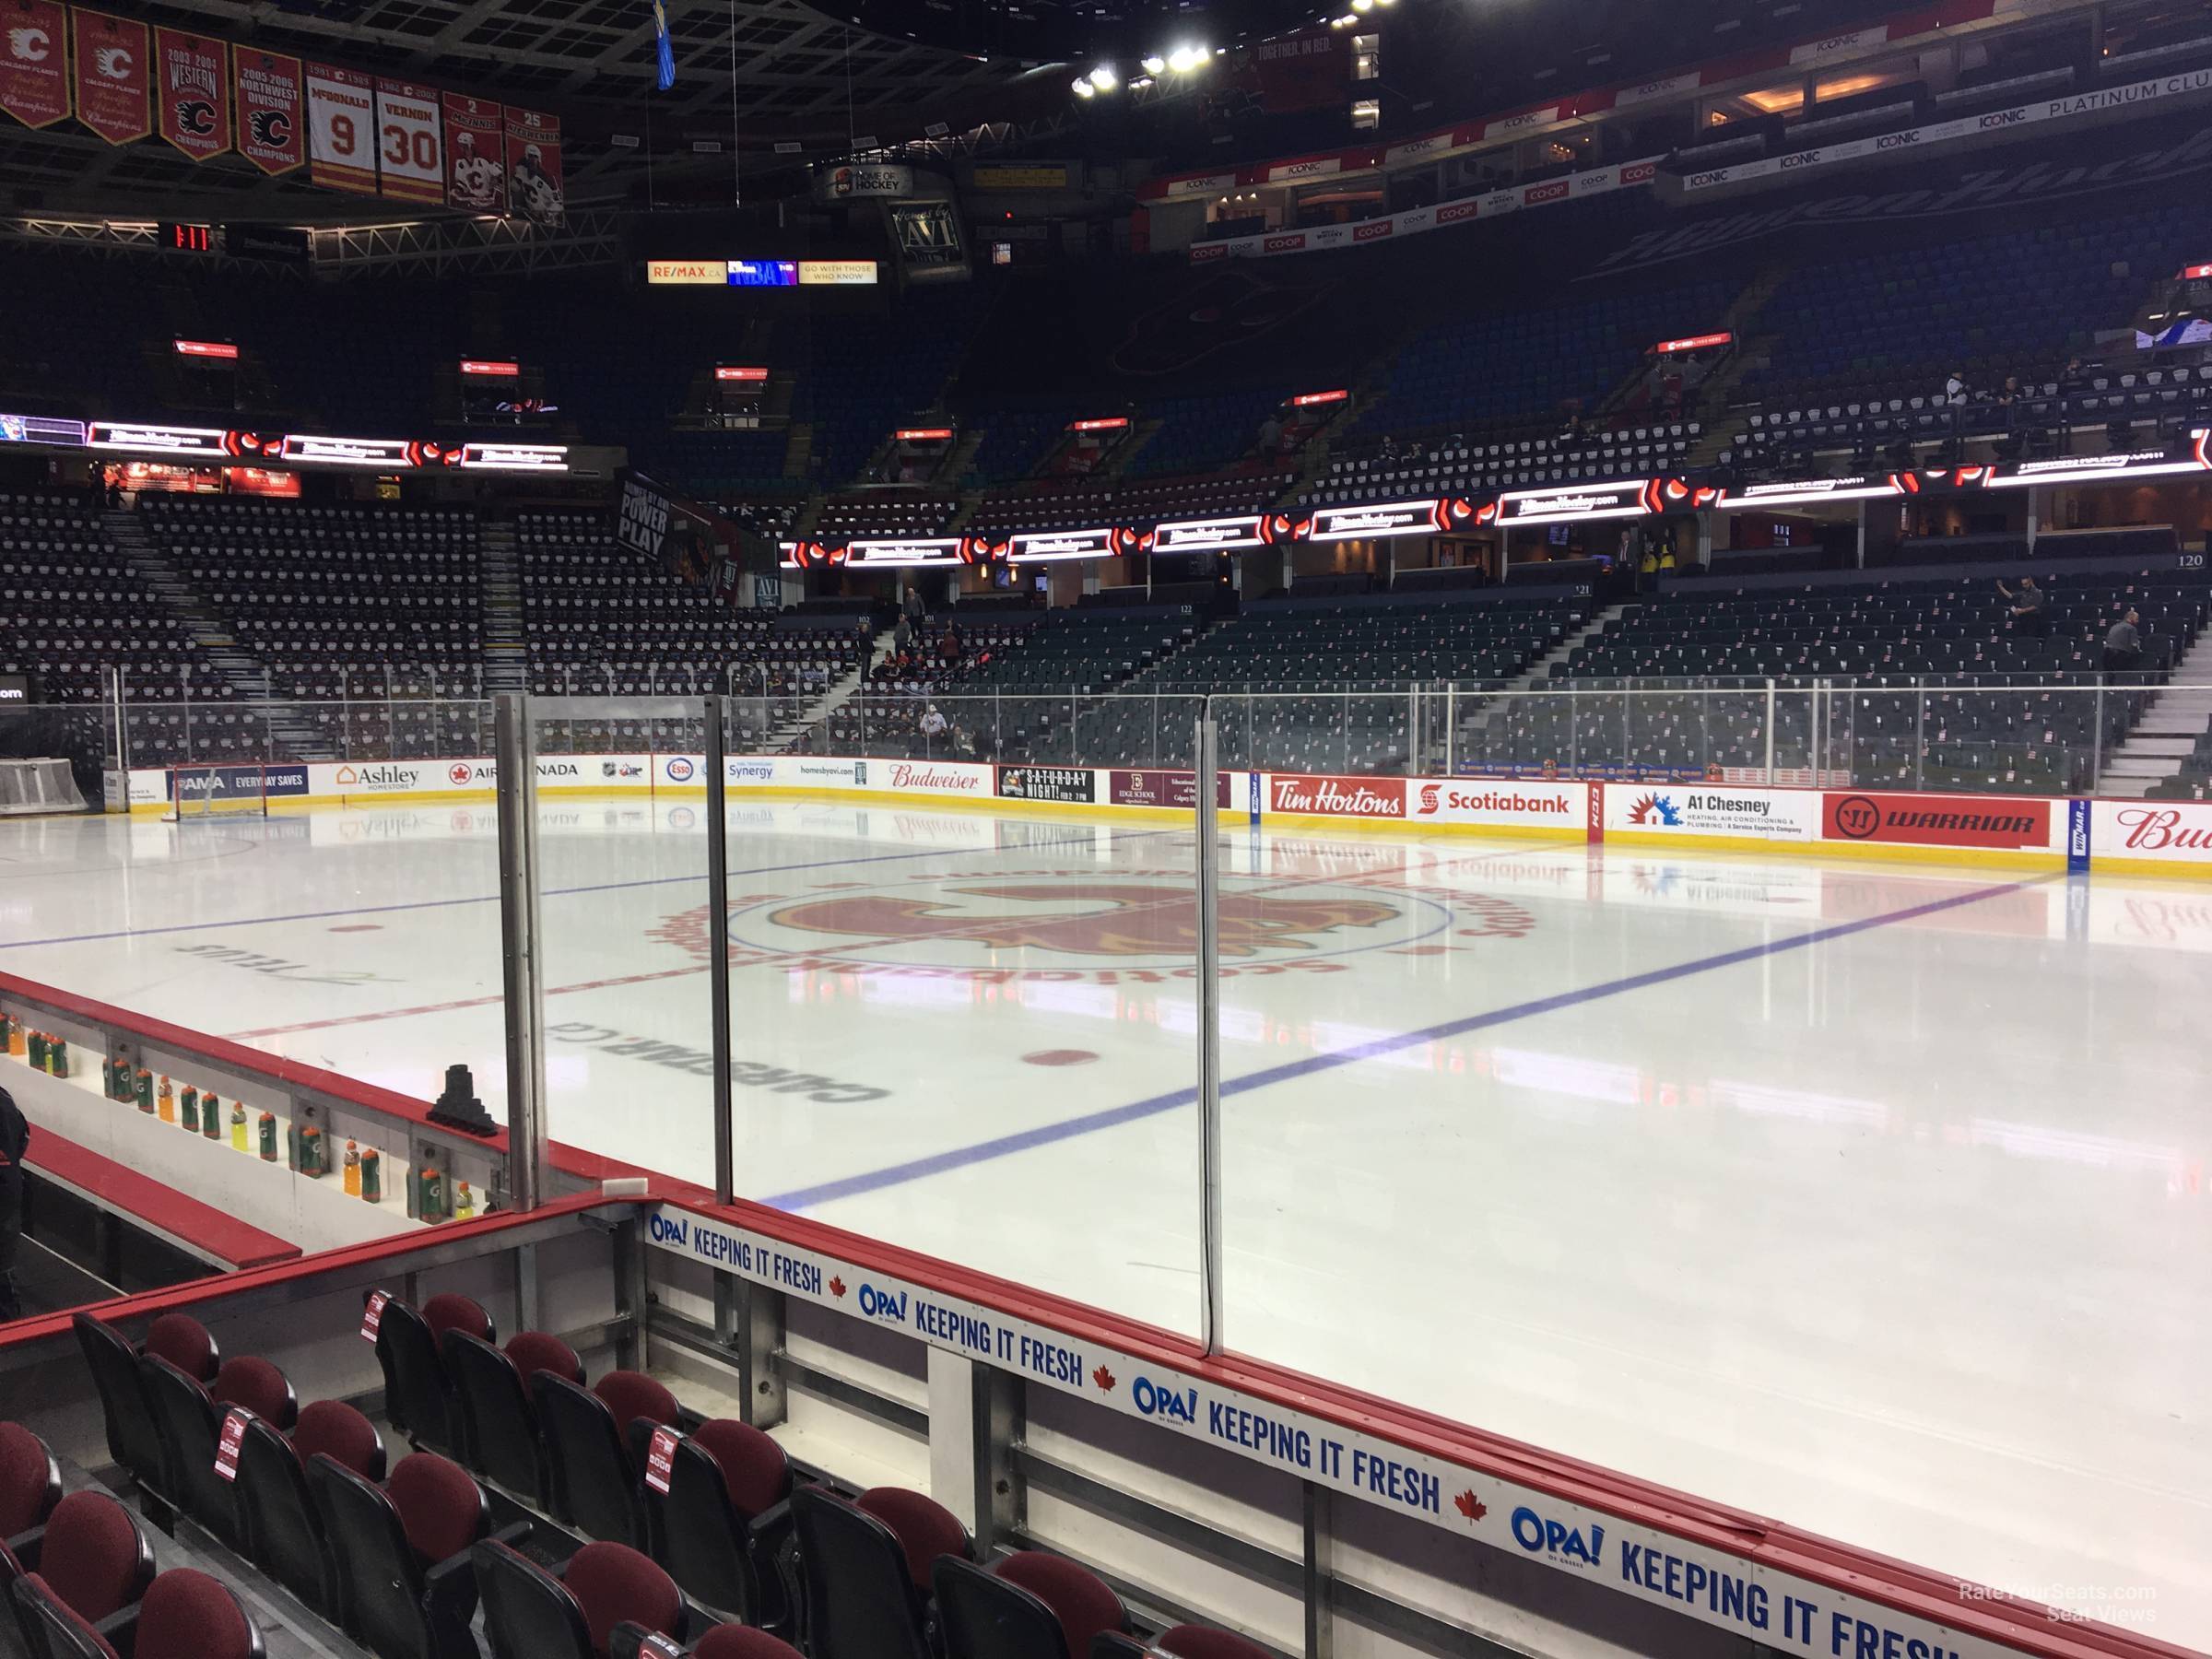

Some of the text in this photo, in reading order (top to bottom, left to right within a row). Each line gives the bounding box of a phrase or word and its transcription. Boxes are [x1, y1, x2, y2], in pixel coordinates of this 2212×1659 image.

[1313, 37, 1333, 53] RED.
[168, 48, 217, 69] 2003 2004
[169, 61, 218, 100] WESTERN
[242, 67, 294, 88] 2005 2006
[309, 65, 330, 77] 1981
[240, 77, 298, 100] NORTHWEST
[248, 90, 291, 112] DIVISION
[468, 100, 477, 113] 2
[2049, 83, 2159, 116] PLATINUM
[384, 102, 432, 123] VERNON
[524, 112, 541, 128] 25
[1980, 109, 2025, 129] ICONIC
[331, 113, 355, 156] 9
[1877, 130, 1920, 150] ICONIC
[246, 145, 296, 163] CHAMPIONS
[383, 124, 437, 171] 30
[1288, 162, 1321, 174] ICONIC
[1780, 150, 1820, 170] ICONIC
[856, 171, 897, 181] HOME OF
[856, 181, 900, 190] HOCKEY
[1690, 169, 1728, 188] ICONIC
[653, 265, 706, 277] RE/MAX
[621, 494, 667, 535] POWER
[618, 516, 665, 557] PLAY
[2178, 554, 2204, 568] 120
[1575, 585, 1589, 594] 121
[924, 614, 935, 622] 101
[1181, 605, 1192, 613] 122
[359, 766, 419, 786] Ashley
[535, 764, 579, 776] NADA
[671, 764, 690, 774] Esso
[729, 764, 773, 780] Synergy
[889, 764, 980, 790] Budweiser
[235, 774, 303, 789] EVERYAY SAVES
[1027, 783, 1059, 800] NIGHT!
[1119, 790, 1156, 799] EDGE SCHOOL
[1275, 780, 1312, 810] Tim
[1448, 791, 1570, 814] Scotiabank
[1592, 787, 1600, 828] CCM
[1688, 794, 1771, 817] A1 Chesney
[1687, 821, 1723, 830] PLUMBING
[1776, 826, 1802, 834] Company
[1734, 817, 1788, 825] CONDITIONING
[1886, 811, 2035, 833] WARRIOR
[172, 945, 310, 973] TELUS
[771, 959, 1347, 985] Scotiabank
[650, 1212, 821, 1295] OPA! KEEPING IT FRESH
[858, 1283, 1083, 1387] OPA! KEEPING IT FRESH
[1133, 1376, 1440, 1514] OPA! KEEPING IT FRESH
[1511, 1506, 1811, 1645] OPA! KEEPING IT
